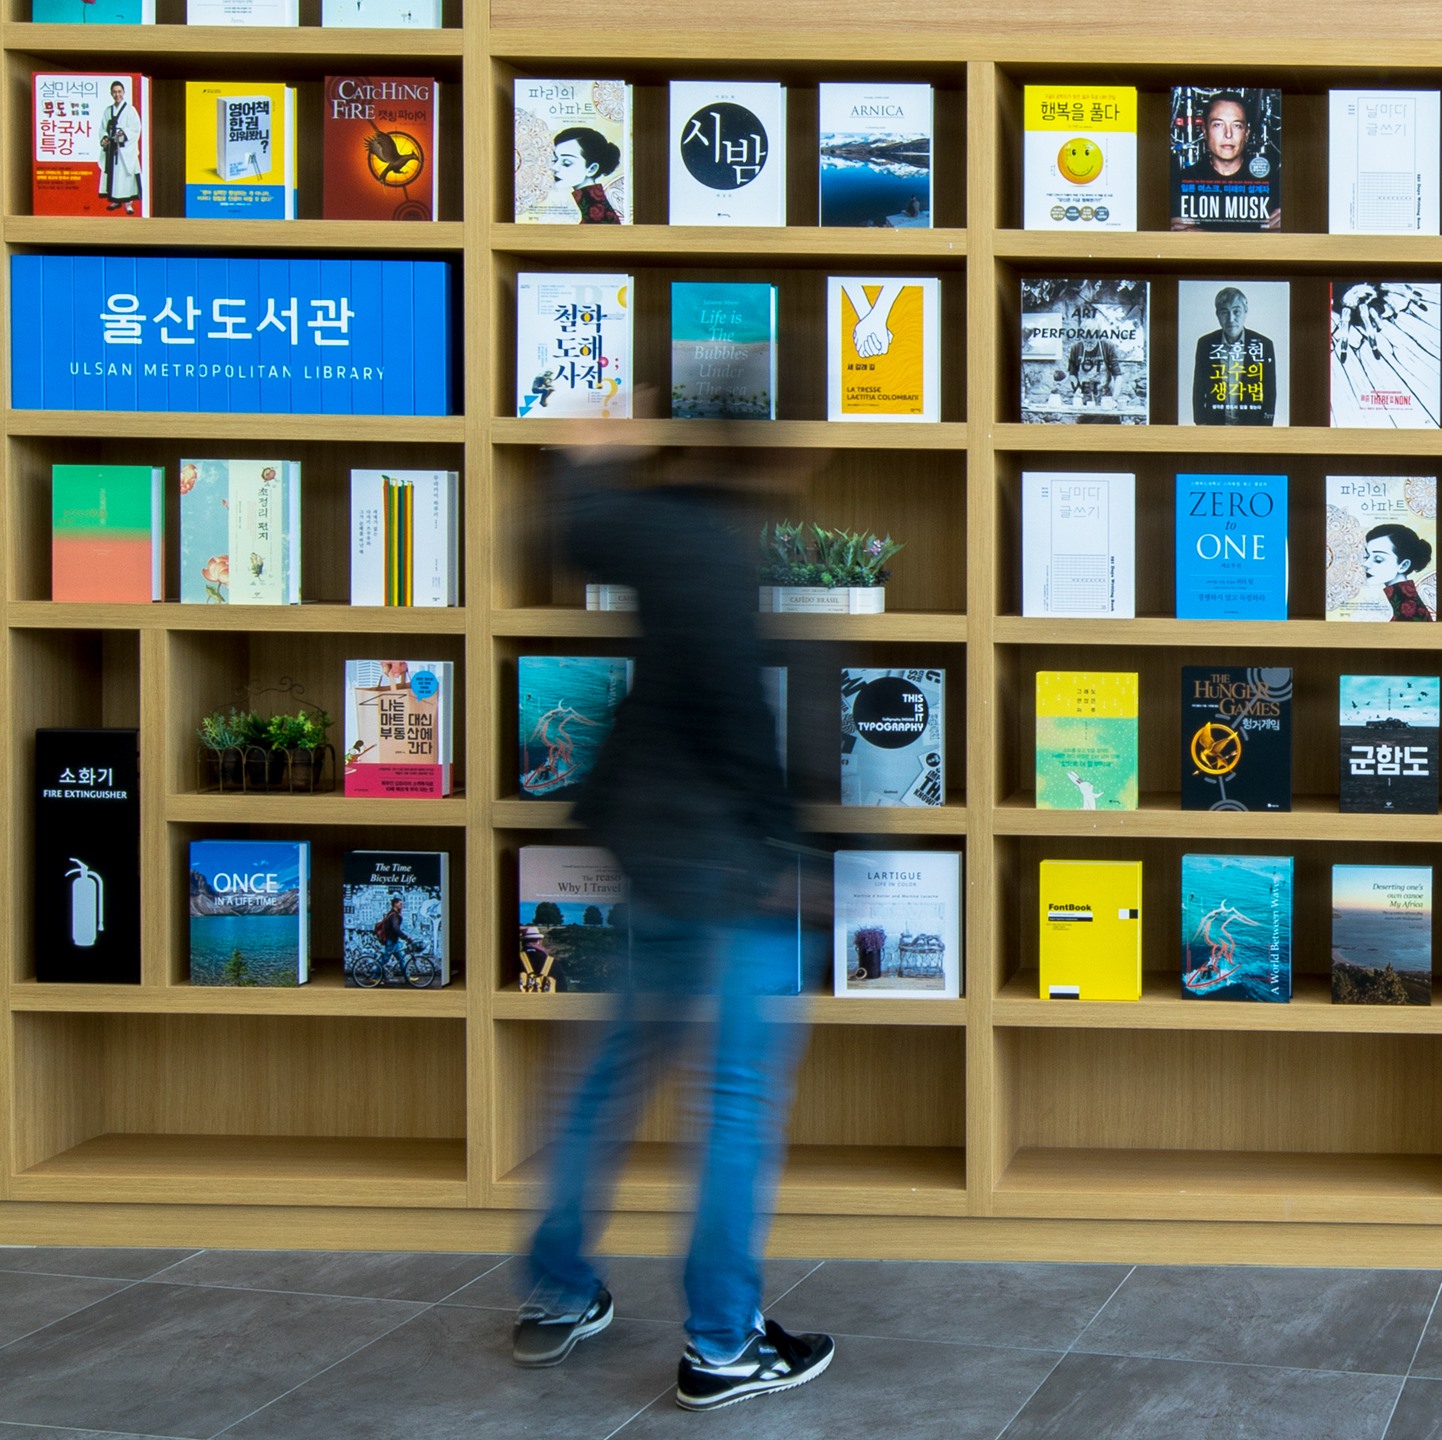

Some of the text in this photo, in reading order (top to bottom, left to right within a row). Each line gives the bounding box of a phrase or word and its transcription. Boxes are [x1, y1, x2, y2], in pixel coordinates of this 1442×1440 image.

[40, 80, 98, 98] 설민석의
[528, 86, 576, 101] 파리의
[229, 101, 270, 117] 영어책
[549, 102, 596, 116] 아파트
[850, 105, 904, 117] ARNICA
[1040, 102, 1121, 123] 행복을 풀다
[40, 120, 91, 138] 한국사
[229, 116, 259, 130] 한 권
[40, 138, 73, 155] 특강
[1181, 196, 1269, 219] ELON MUSK
[100, 293, 355, 346] 울산도서관
[553, 304, 606, 334] 철학
[1071, 307, 1099, 319] ART
[1033, 327, 1136, 341] PERFORMANCE
[553, 334, 604, 361] 도해
[1209, 343, 1272, 362] 조훈현,
[70, 362, 386, 380] ULSAN METROPOLITAN LIBRARY
[553, 361, 604, 390] 사전
[1209, 363, 1264, 382] 고수의
[1210, 382, 1264, 402] 생각법
[1189, 491, 1274, 516] ZERO
[257, 486, 269, 541] 초정리 편지
[1225, 520, 1236, 531] to
[1196, 534, 1265, 560] ONE
[1211, 673, 1230, 683] THE
[1194, 681, 1270, 700] HUNGER
[380, 699, 405, 712] 나는
[1219, 700, 1280, 716] GAMES
[380, 713, 432, 726] 마트 대신
[407, 741, 432, 755] 간다
[1349, 746, 1429, 777] 군함도
[59, 766, 112, 786] 소화기
[43, 790, 127, 800] FIRE EXTINGUISHER
[375, 864, 411, 872] The Time
[867, 871, 922, 881] LARTIGUE
[213, 873, 278, 893] ONCE
[370, 874, 416, 884] Bicycle Life
[1372, 882, 1406, 892] Deserting
[214, 898, 276, 906] IN A LIFE TIME
[1048, 903, 1091, 912] FontBook
[1389, 900, 1423, 909] My Africa
